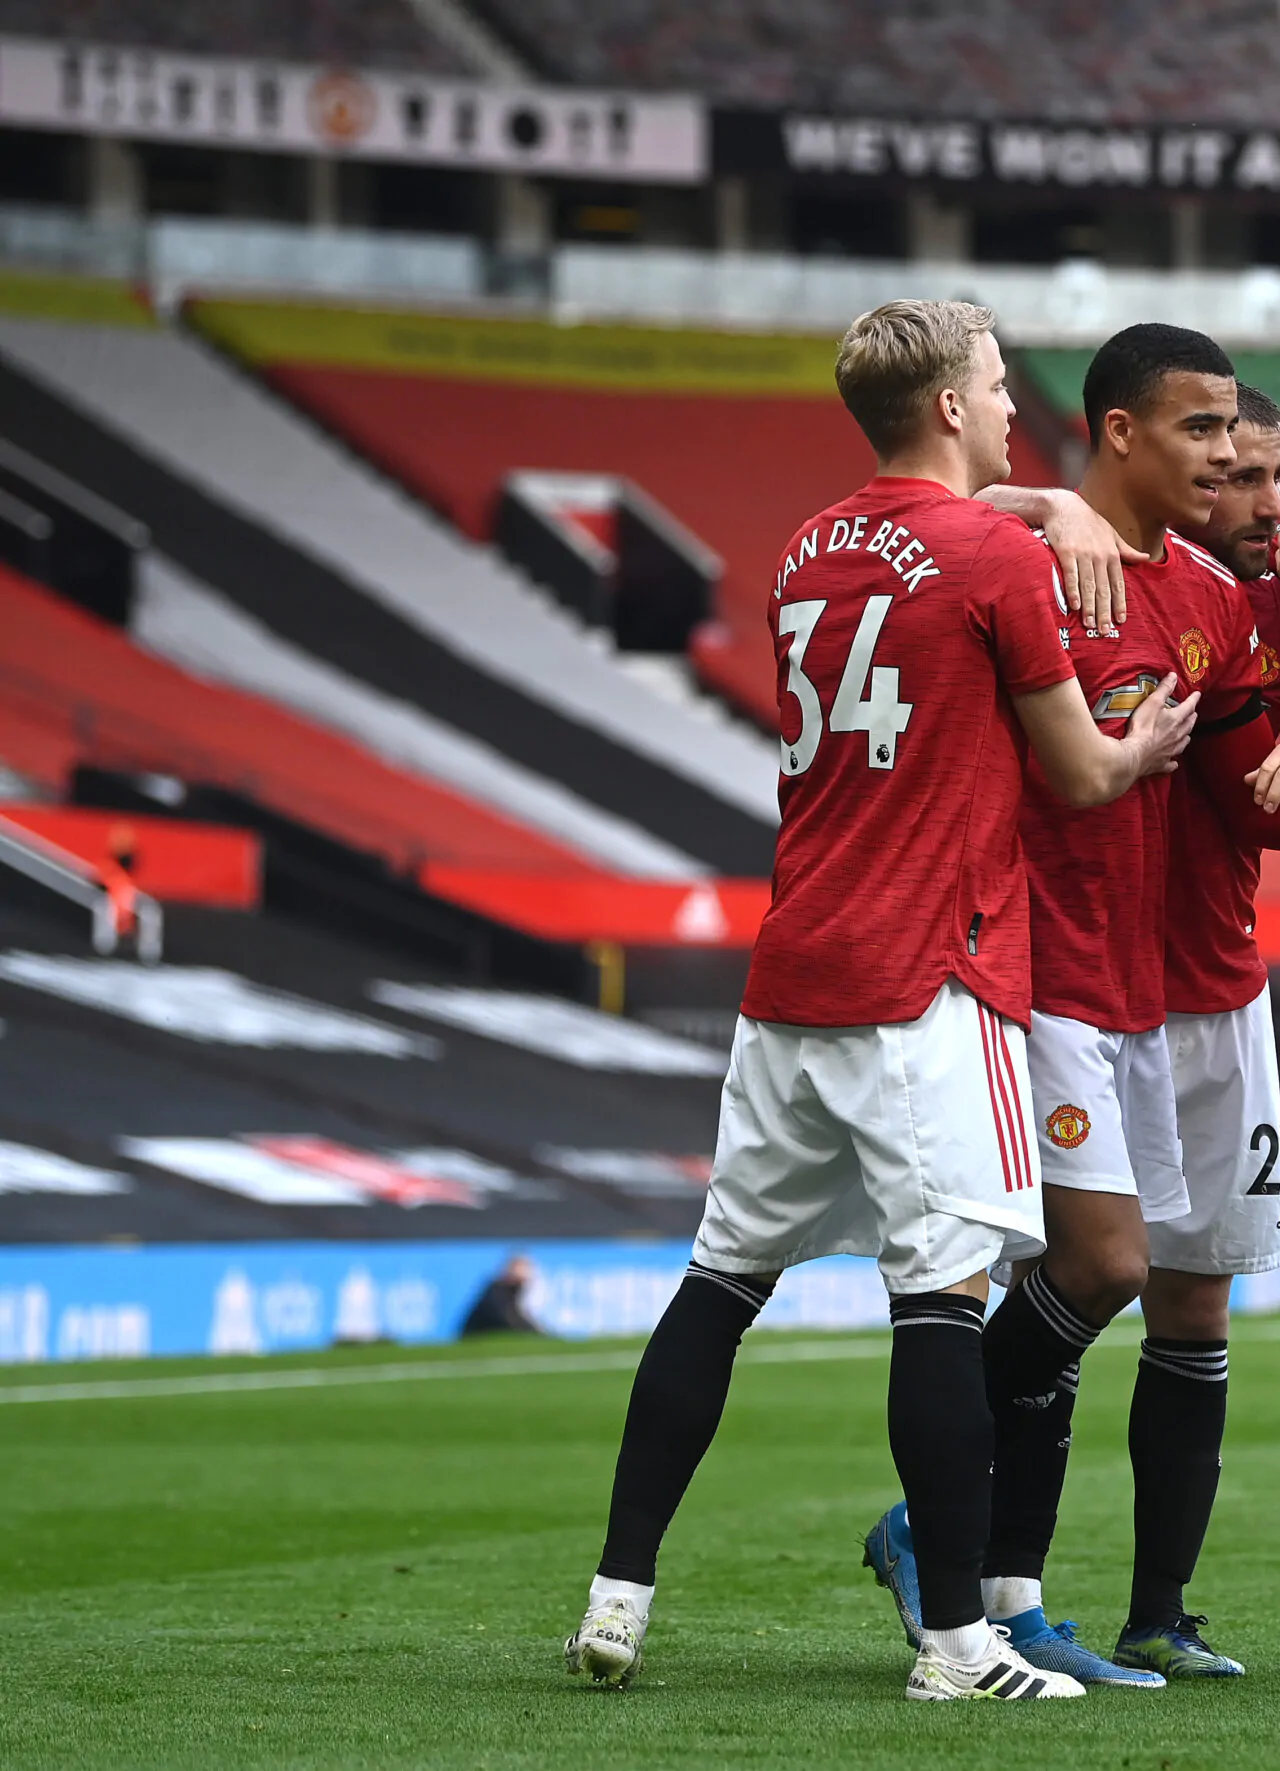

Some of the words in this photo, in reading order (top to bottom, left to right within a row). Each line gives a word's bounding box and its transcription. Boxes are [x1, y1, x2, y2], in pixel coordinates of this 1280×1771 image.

[992, 122, 1149, 187] WON
[826, 516, 868, 553] DE
[866, 519, 941, 594] BEEK
[778, 594, 914, 777] 34
[596, 1629, 629, 1645] COPA
